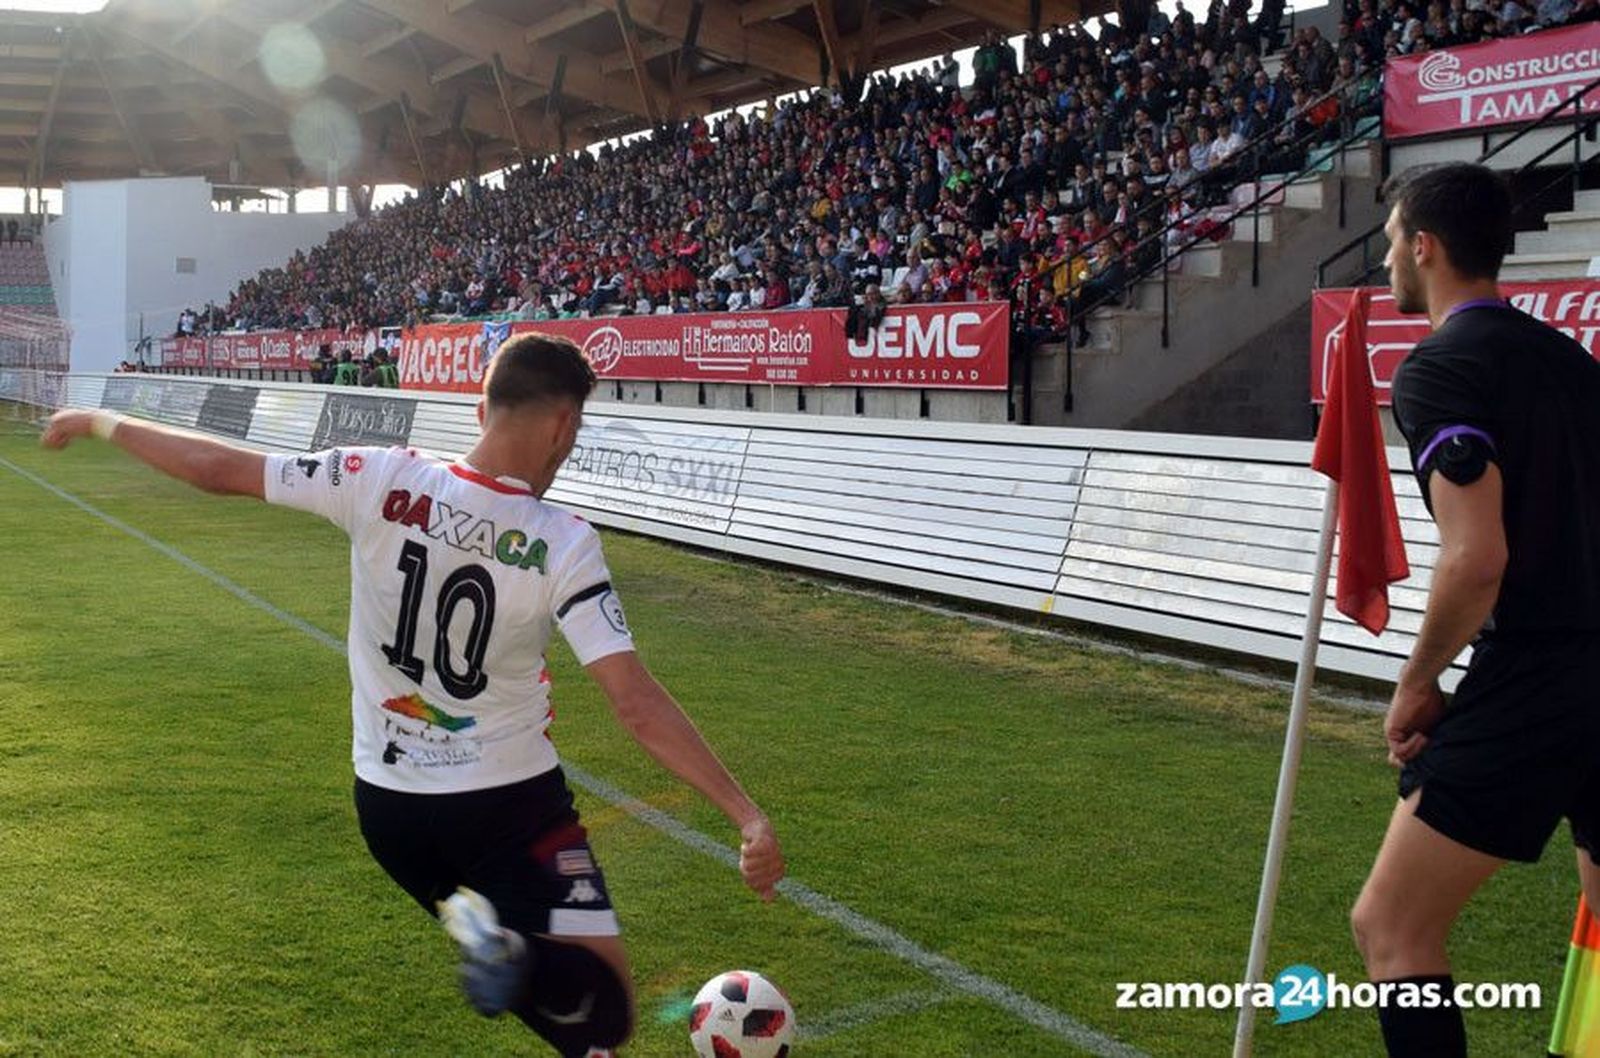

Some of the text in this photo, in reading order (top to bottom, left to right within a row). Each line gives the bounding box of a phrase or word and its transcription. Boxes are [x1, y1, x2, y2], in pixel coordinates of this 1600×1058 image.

[1418, 49, 1600, 91] CONSTRUCCI
[1459, 84, 1600, 124] TAMAR
[623, 339, 680, 357] ELECTRICIDAD
[703, 324, 812, 353] Hermanos Ratón
[850, 369, 979, 381] UNIVERSIDAD
[382, 489, 549, 576] OAXACA
[381, 538, 497, 700] 10
